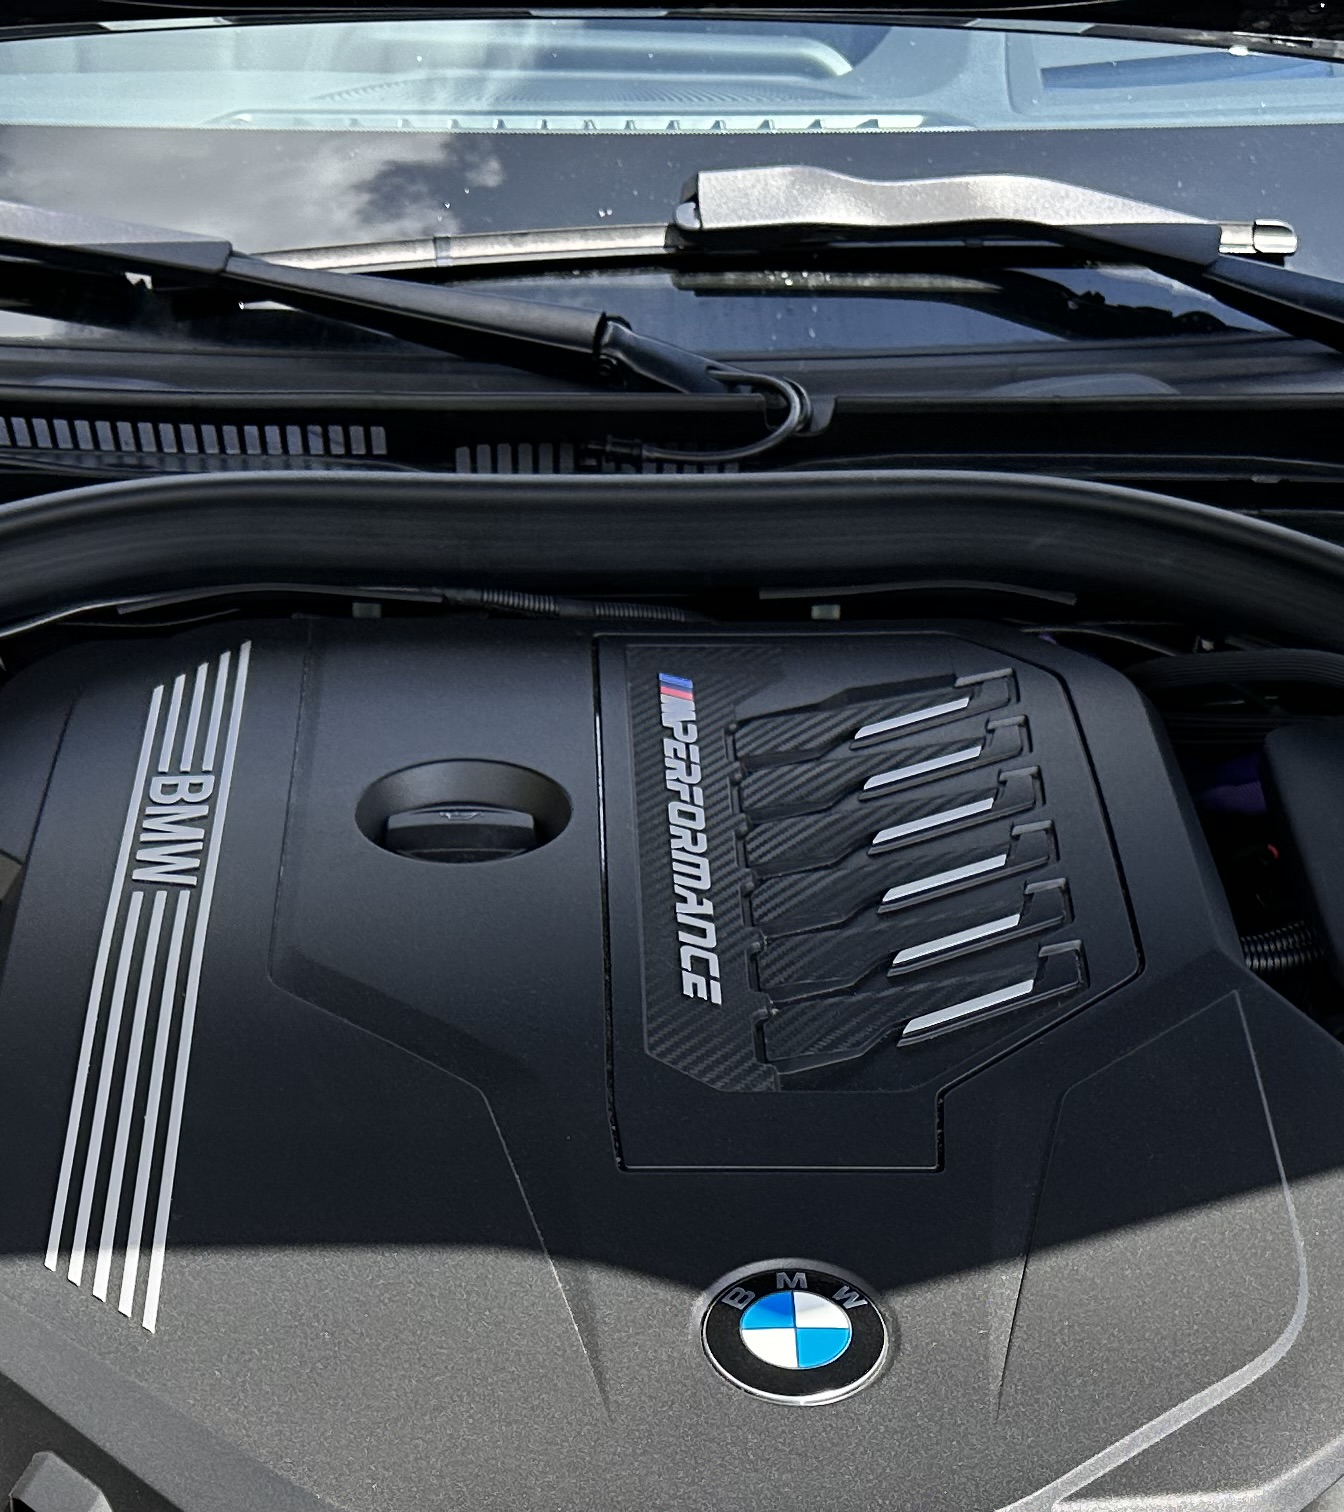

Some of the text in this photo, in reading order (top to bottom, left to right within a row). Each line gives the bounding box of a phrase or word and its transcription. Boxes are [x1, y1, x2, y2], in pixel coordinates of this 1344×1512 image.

[131, 774, 216, 887] BMW
[662, 720, 722, 1005] PERFORMANCE
[722, 1271, 869, 1311] BMW
